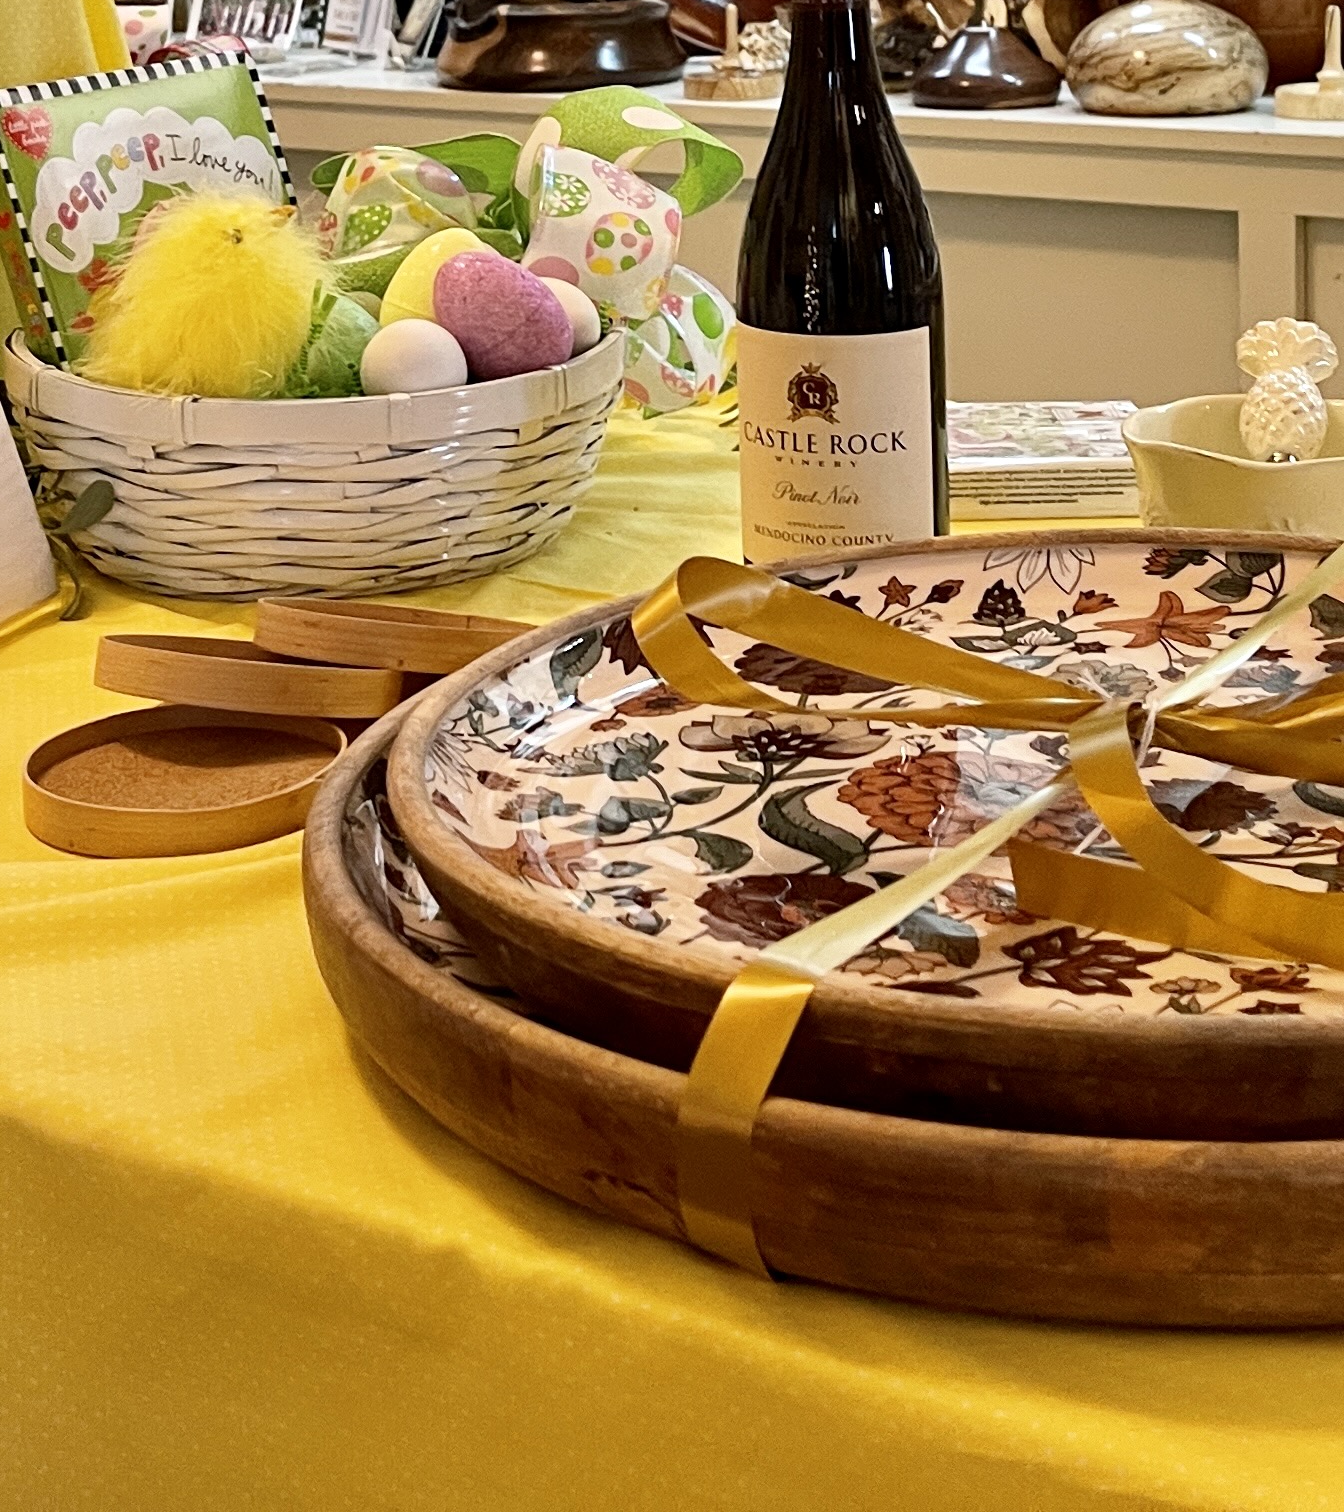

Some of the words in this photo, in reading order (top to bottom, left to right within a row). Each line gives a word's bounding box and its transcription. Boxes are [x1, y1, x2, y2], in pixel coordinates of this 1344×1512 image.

[165, 133, 187, 162] I
[188, 136, 233, 173] love
[743, 420, 819, 455] CASTLE
[829, 430, 908, 456] ROCK
[774, 455, 859, 469] WINERY
[771, 479, 820, 505] Pinot
[819, 483, 861, 507] Noir
[753, 523, 827, 546] MENDOCINO
[831, 532, 895, 547] COUNTY
